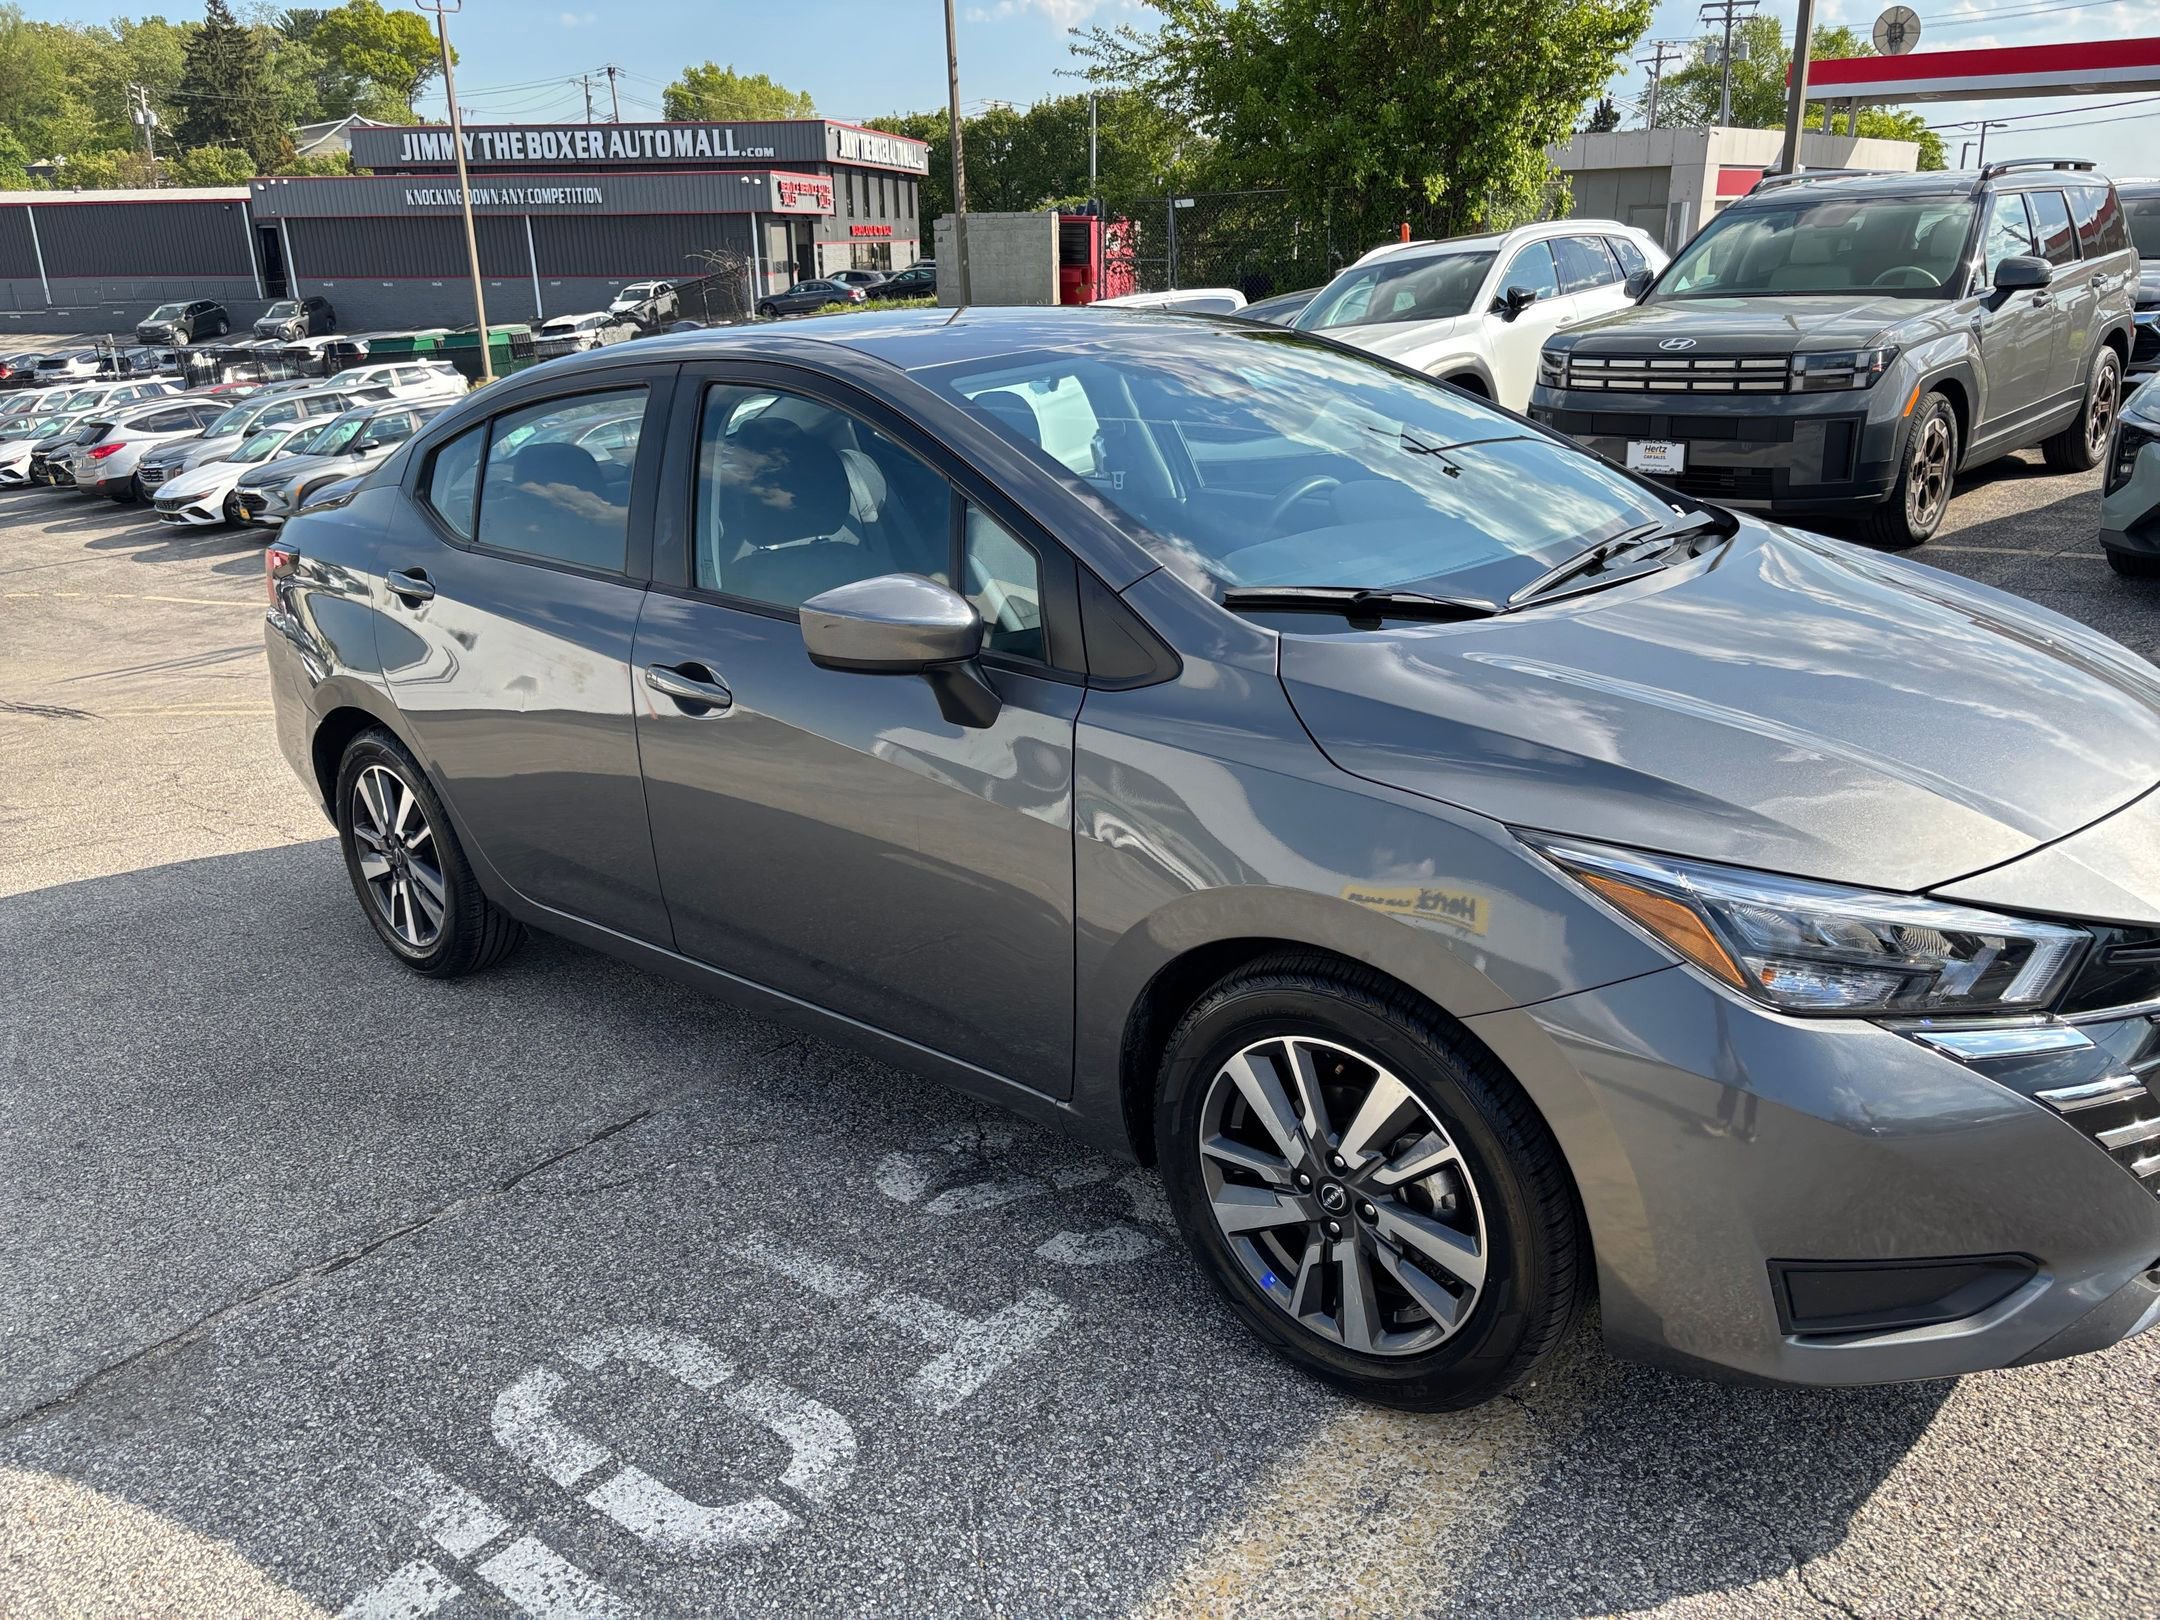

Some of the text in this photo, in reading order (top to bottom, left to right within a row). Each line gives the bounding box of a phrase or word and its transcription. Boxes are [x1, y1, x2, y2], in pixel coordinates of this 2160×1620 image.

[400, 132, 475, 161] JIMMY
[478, 131, 525, 160] THE
[525, 130, 606, 160] BOXER
[405, 187, 603, 206] KNOCKING DOWN ANY COMPETITION
[1644, 445, 1668, 453] Hertz
